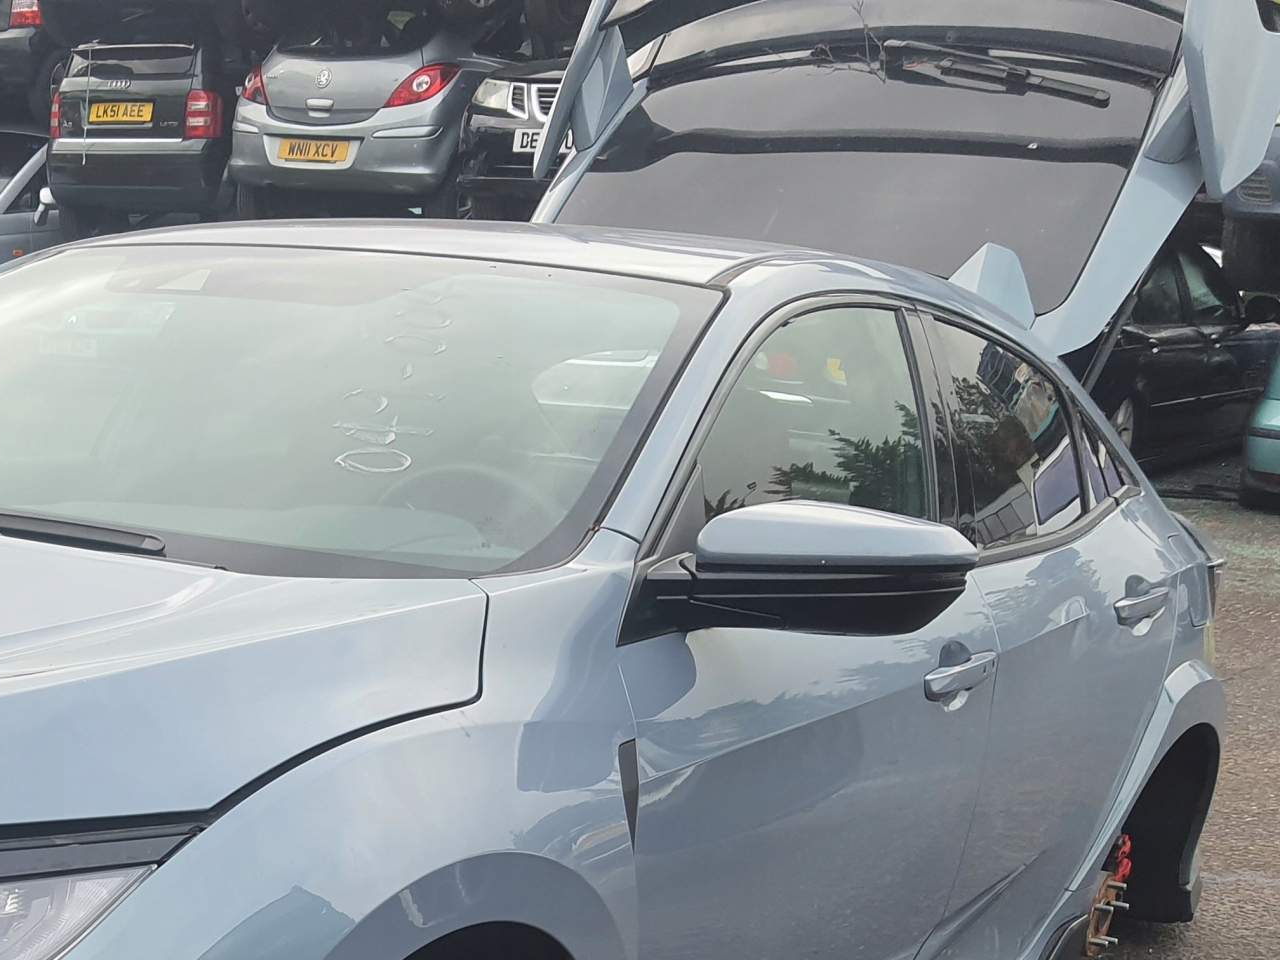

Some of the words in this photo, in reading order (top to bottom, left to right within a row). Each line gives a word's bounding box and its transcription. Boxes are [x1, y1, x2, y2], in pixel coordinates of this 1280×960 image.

[95, 104, 120, 119] LK51
[122, 104, 145, 118] AEE
[287, 141, 311, 157] WN11
[313, 143, 338, 158] XCV
